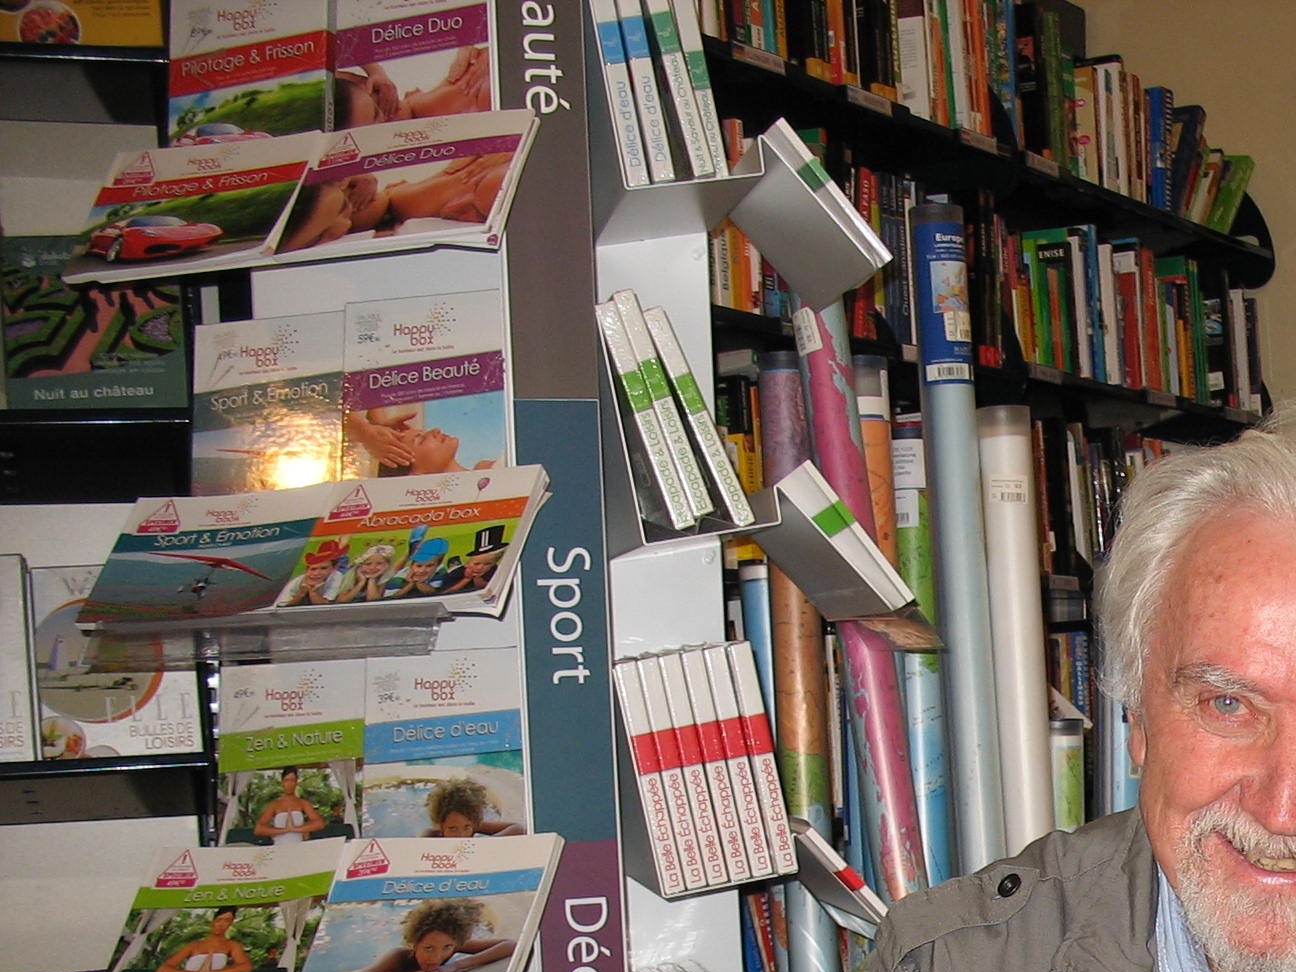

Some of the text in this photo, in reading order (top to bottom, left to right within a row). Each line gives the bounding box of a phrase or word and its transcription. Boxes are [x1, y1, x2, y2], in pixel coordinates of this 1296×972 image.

[371, 13, 464, 44] Délice Duo
[181, 39, 315, 77] Pilotage & Frisson
[616, 81, 642, 168] Délice d'eau
[641, 75, 667, 162] Délice d'eau
[363, 144, 457, 170] Délice Duo
[132, 170, 269, 198] Pilotage & Frisson
[393, 322, 435, 339] Happy
[410, 333, 435, 347] box
[369, 357, 482, 390] Délice Beauté
[33, 384, 154, 401] Nuit au château
[211, 392, 250, 413] Sport
[267, 379, 329, 402] Emotion
[360, 503, 481, 531] Abracada'box
[155, 523, 281, 549] Sport & Emotion
[545, 546, 592, 686] Sport
[414, 676, 457, 693] Happy
[430, 688, 456, 703] box
[177, 720, 195, 736] DE
[245, 726, 344, 752] Zen & Nature
[392, 718, 499, 745] Délice d'eau
[145, 734, 195, 750] LOISIRS
[705, 834, 719, 863] Belle
[728, 831, 742, 859] Belle
[750, 826, 764, 854] Belle
[776, 823, 791, 852] Belle
[661, 843, 677, 872] Belle
[684, 838, 698, 867] Belle
[758, 855, 769, 871] La
[783, 852, 794, 868] La
[669, 873, 680, 888] La
[691, 868, 702, 884] La
[712, 863, 723, 880] La
[735, 859, 746, 876] La
[184, 886, 212, 904] Zen
[232, 880, 286, 900] Nature
[382, 875, 490, 897] Délice d'eau
